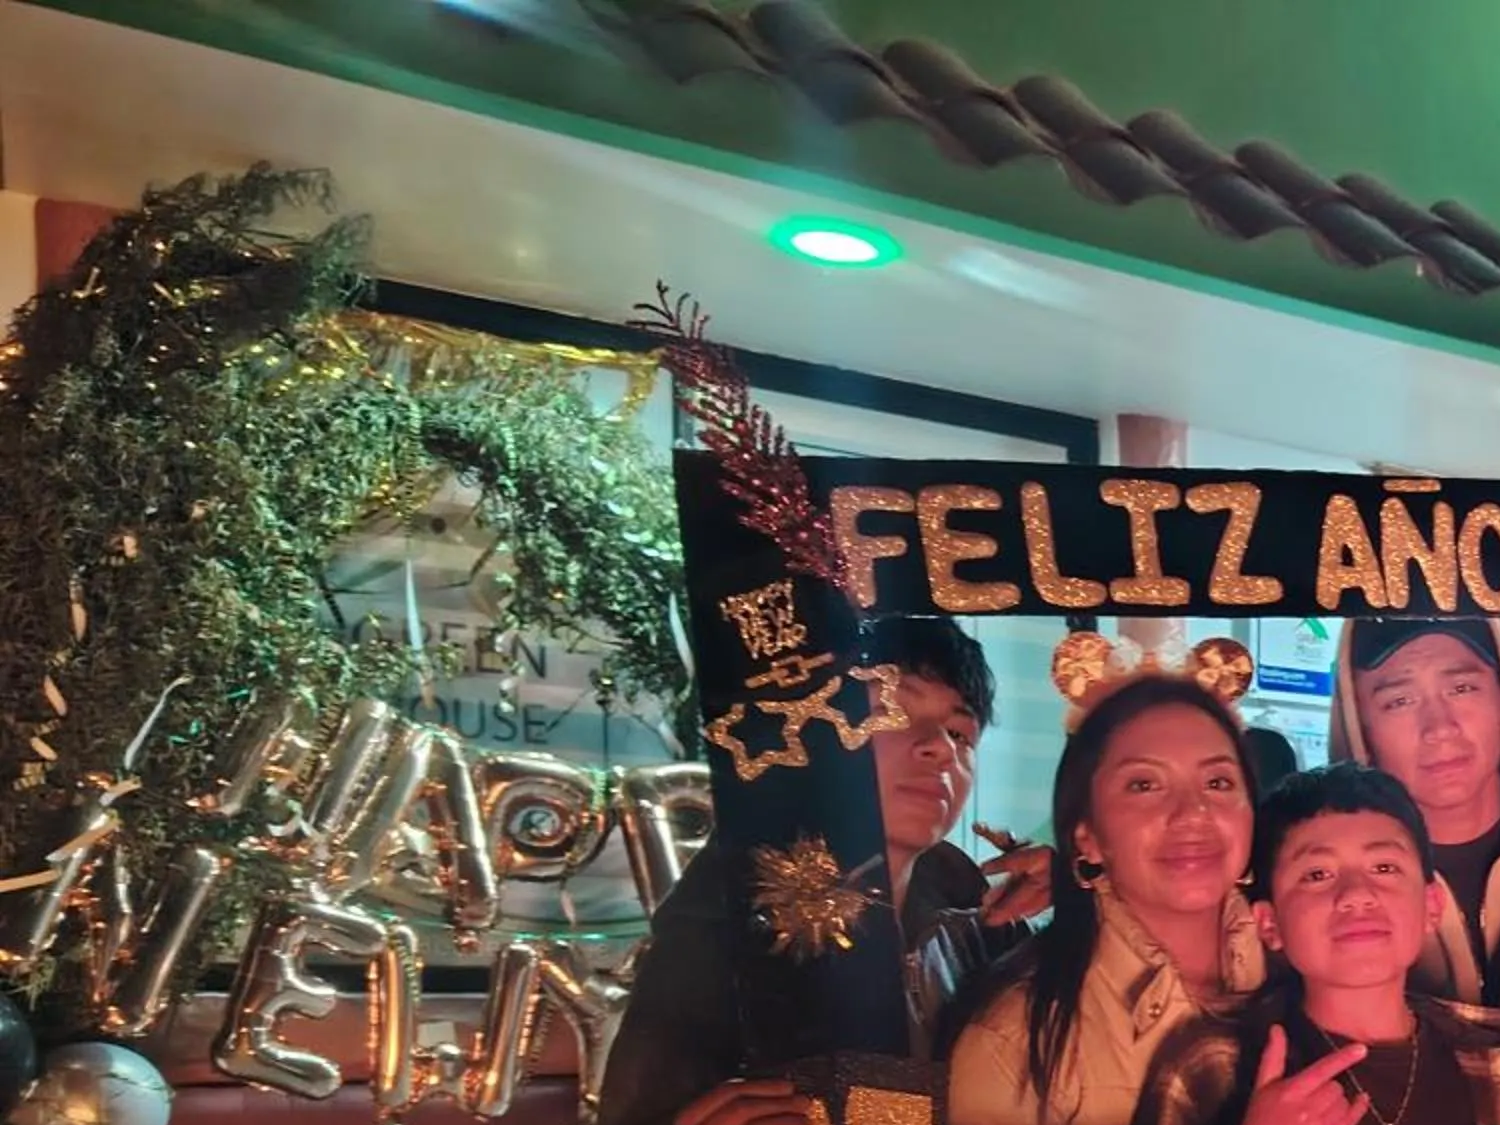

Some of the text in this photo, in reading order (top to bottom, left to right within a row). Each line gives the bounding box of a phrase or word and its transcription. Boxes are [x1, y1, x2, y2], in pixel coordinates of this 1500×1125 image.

[830, 478, 1284, 613] FELIZ
[398, 695, 549, 745] OUSE
[190, 698, 713, 934] HAPP
